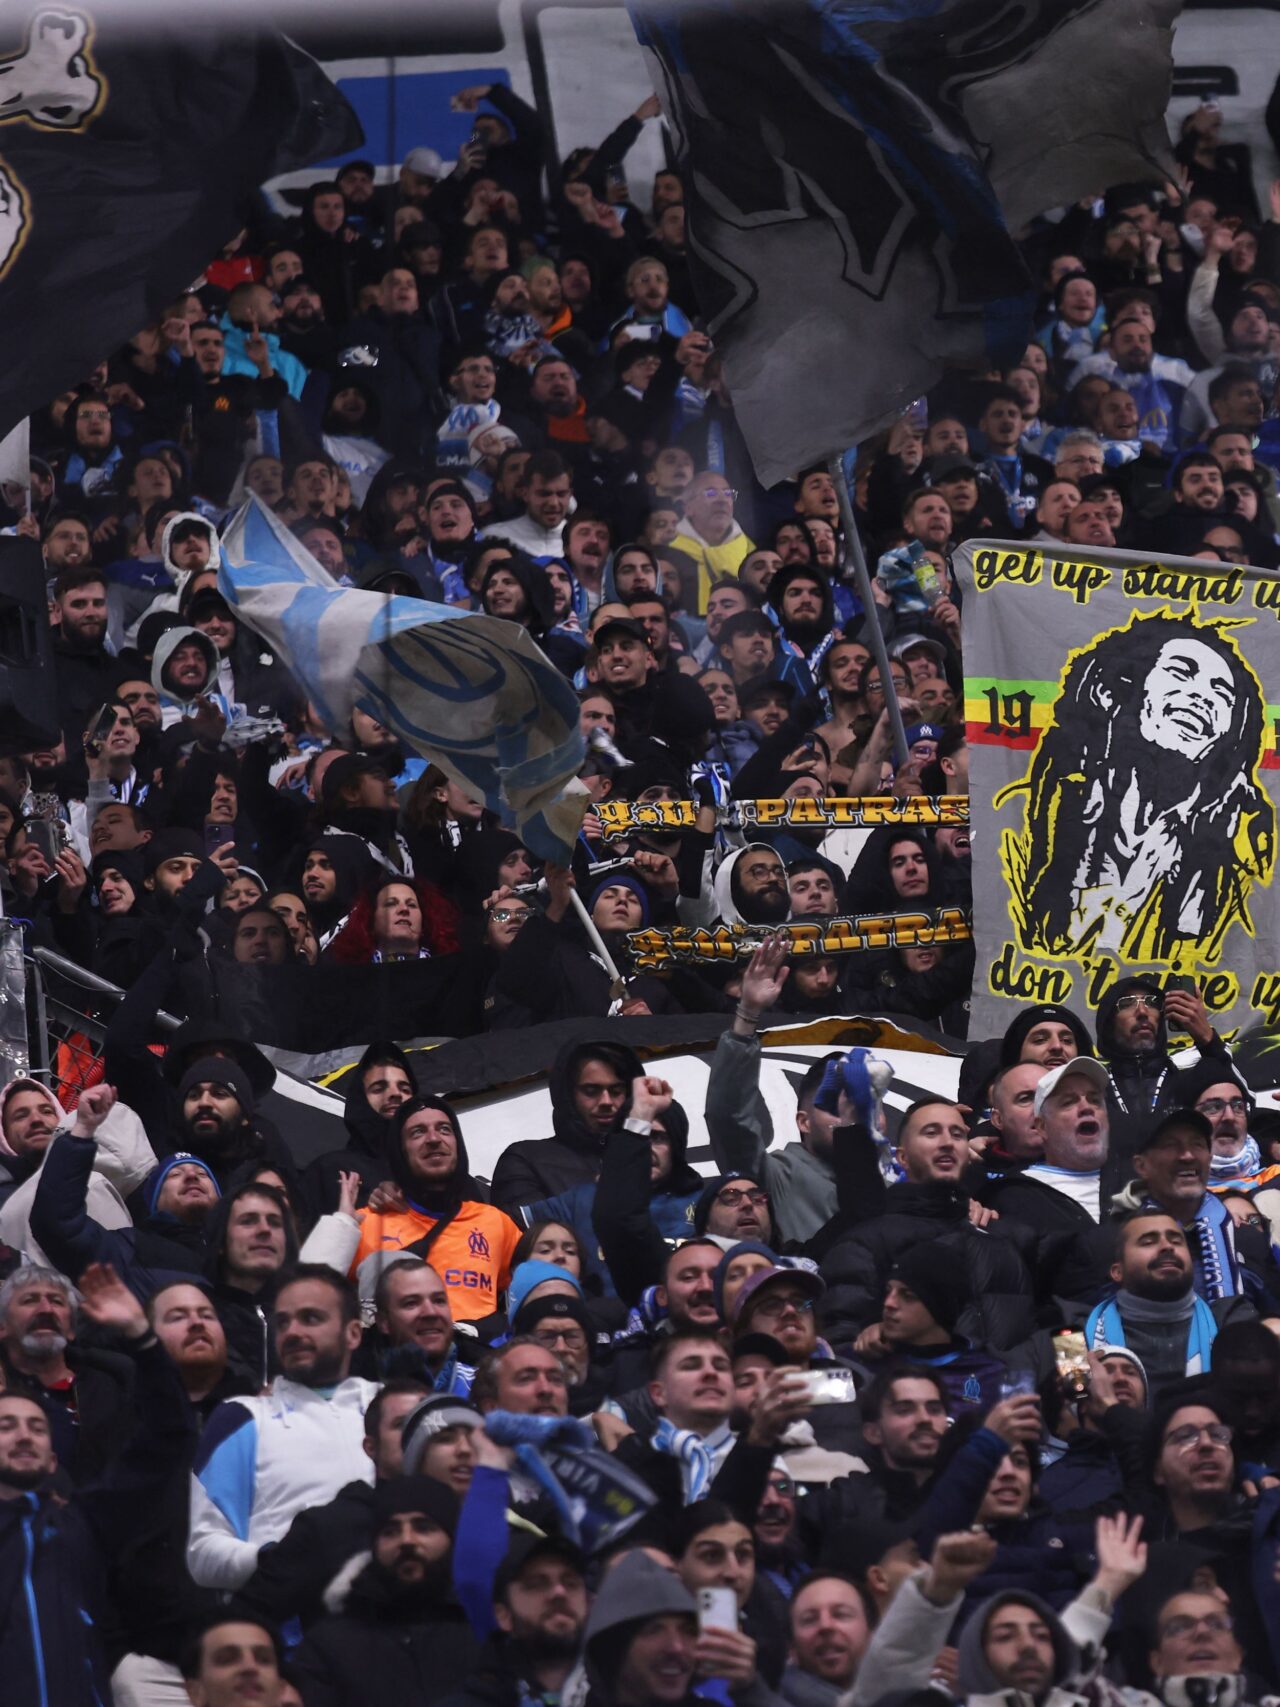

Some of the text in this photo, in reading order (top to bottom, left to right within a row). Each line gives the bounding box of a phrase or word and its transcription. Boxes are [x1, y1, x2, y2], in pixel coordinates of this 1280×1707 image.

[975, 550, 1041, 588] get
[1054, 561, 1112, 603] up
[1124, 563, 1243, 604] stand
[982, 686, 1036, 739] 19
[788, 907, 972, 956] PATRA
[445, 1268, 492, 1292] CGM
